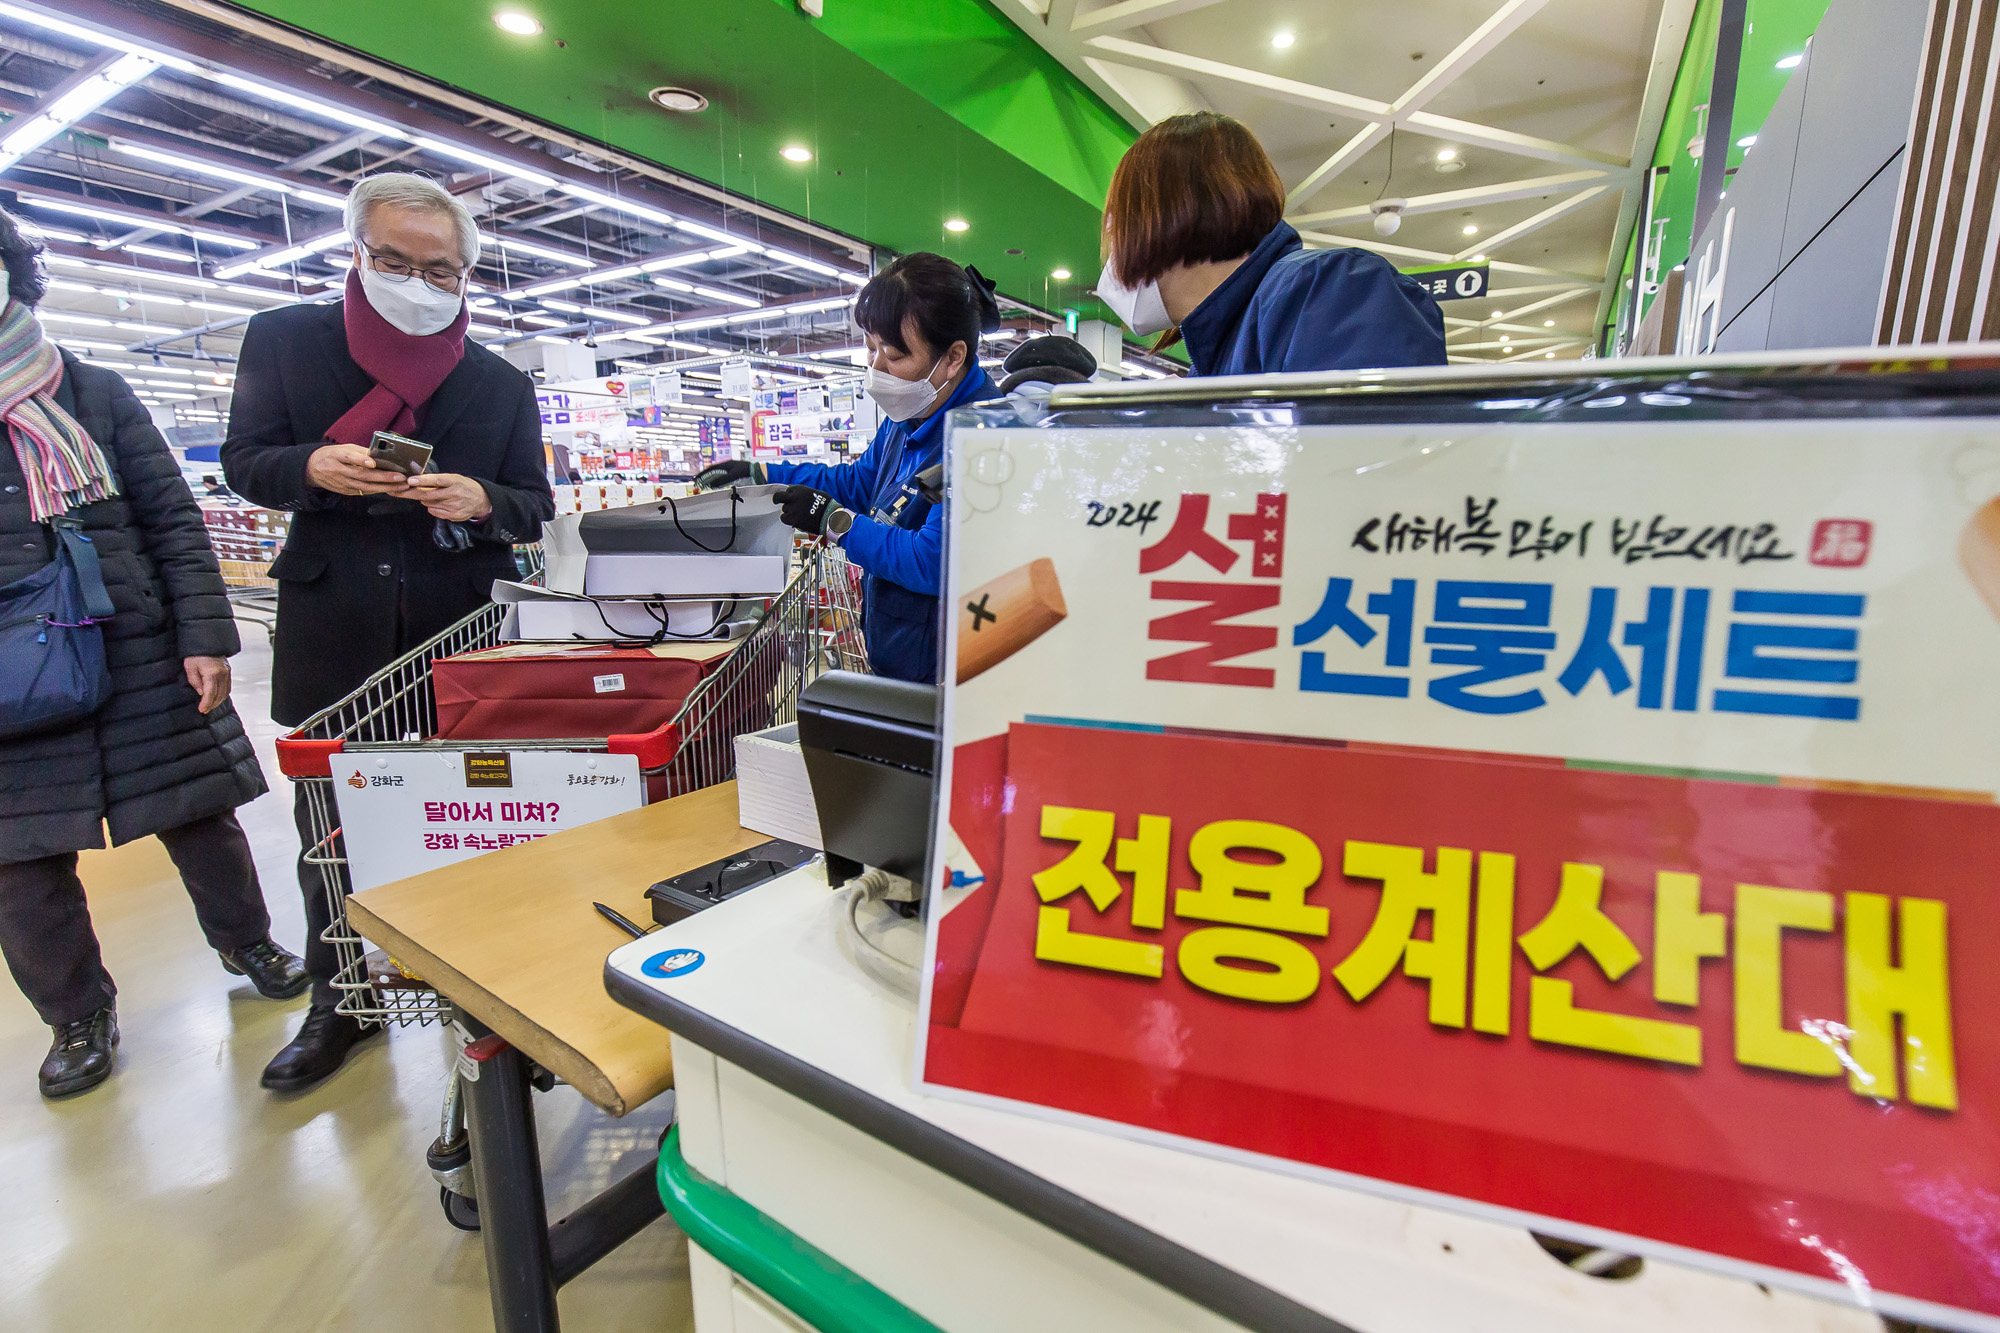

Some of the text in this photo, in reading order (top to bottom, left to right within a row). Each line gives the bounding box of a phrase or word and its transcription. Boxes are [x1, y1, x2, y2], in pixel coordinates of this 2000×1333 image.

[769, 423, 792, 441] 잡곡
[1088, 500, 1163, 535] 2024
[1509, 516, 1594, 561] 많이
[1611, 515, 1796, 564] 받으세요
[1137, 492, 1866, 721] 설 선물세트
[371, 775, 404, 787] 강화군
[566, 774, 597, 786] 풍요로운
[424, 801, 560, 823] 달아서 미쳐?
[424, 833, 460, 850] 강화
[1031, 804, 1958, 1111] 전용계산대
